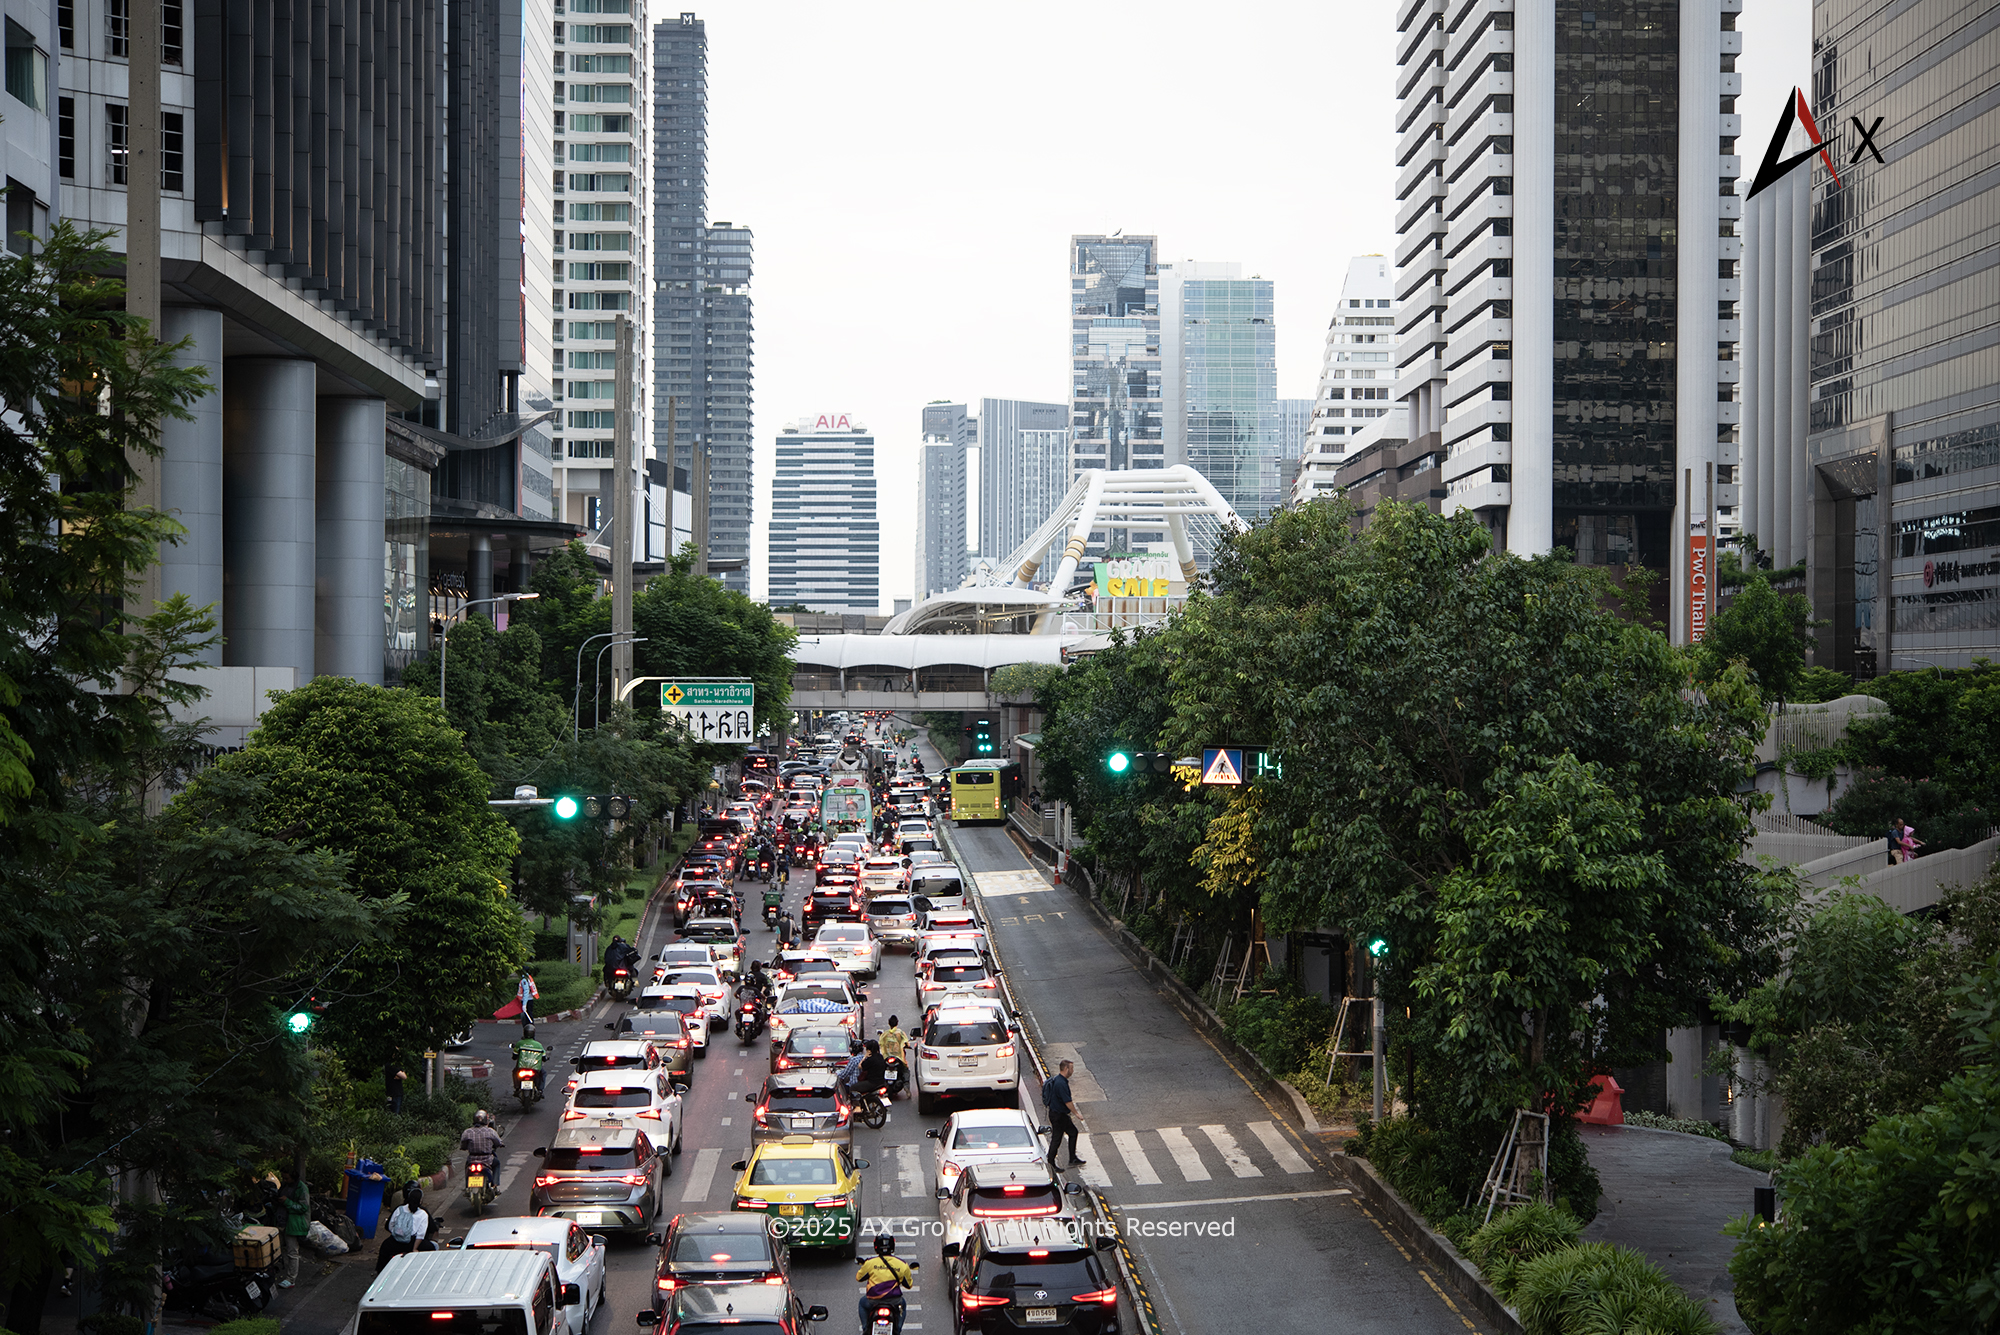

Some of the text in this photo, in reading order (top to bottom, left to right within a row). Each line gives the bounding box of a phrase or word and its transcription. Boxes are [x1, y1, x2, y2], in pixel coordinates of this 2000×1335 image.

[815, 414, 850, 429] AIA
[1106, 560, 1169, 580] GRAND
[1692, 546, 1707, 642] PwC Thaila
[686, 685, 751, 697] สาทร-นราธิวาส
